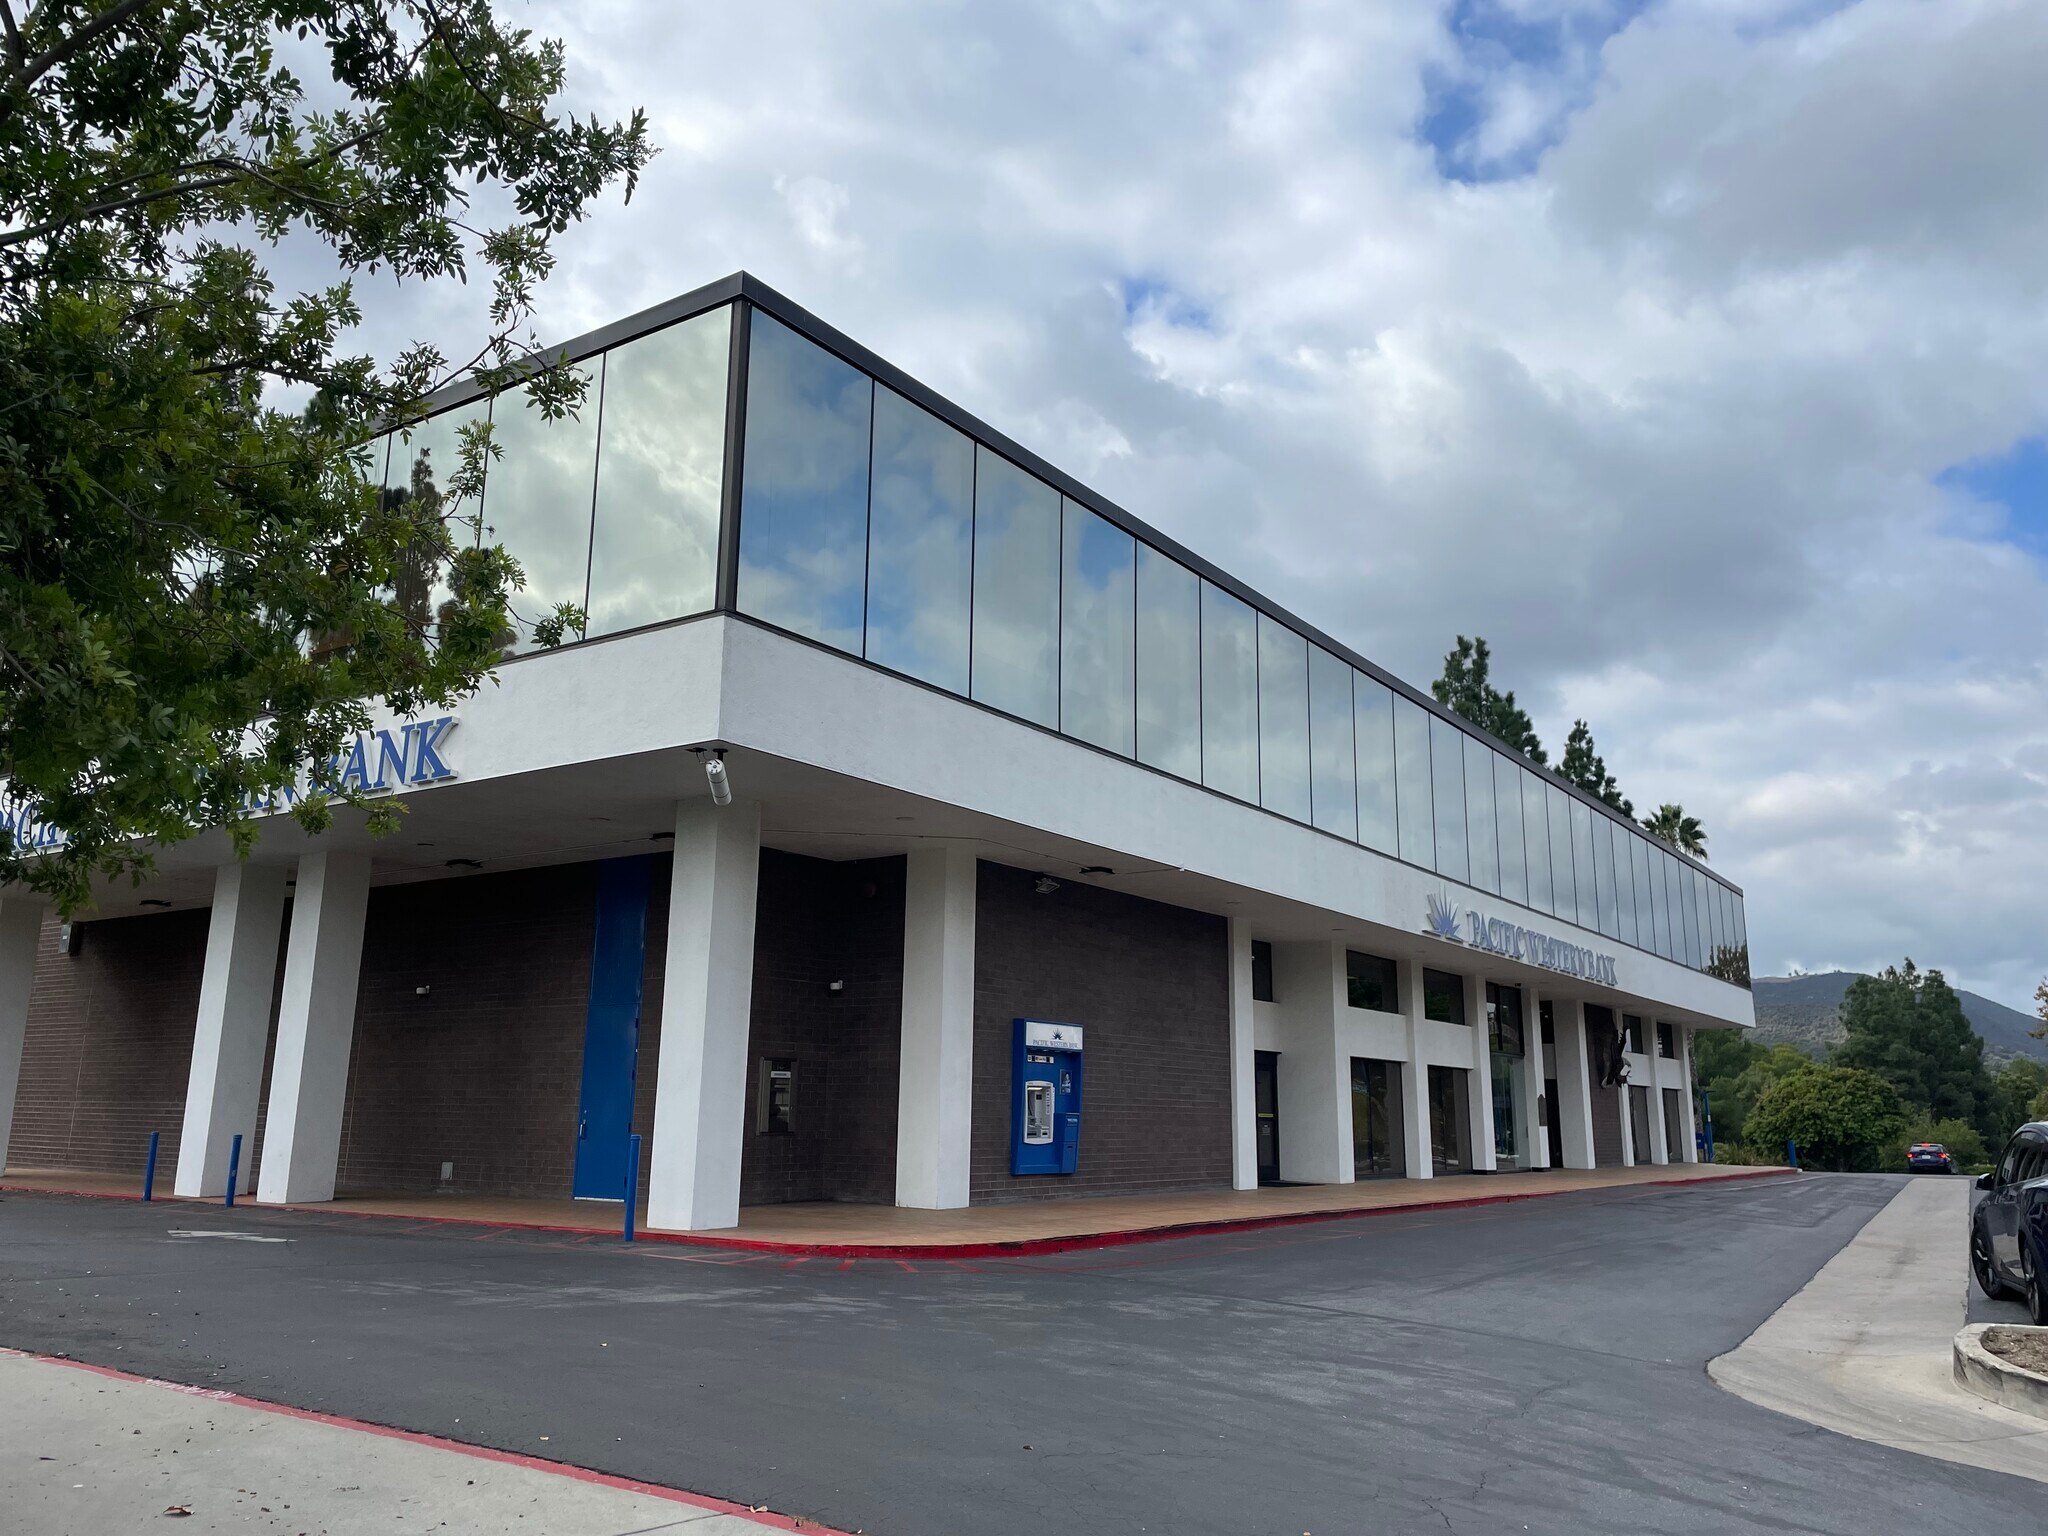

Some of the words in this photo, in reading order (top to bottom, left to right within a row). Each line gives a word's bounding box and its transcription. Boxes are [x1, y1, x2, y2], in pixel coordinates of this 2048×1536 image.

[1469, 910, 1525, 959] PACIFIC
[1525, 929, 1585, 977] WESTERN
[1585, 948, 1618, 985] BANK
